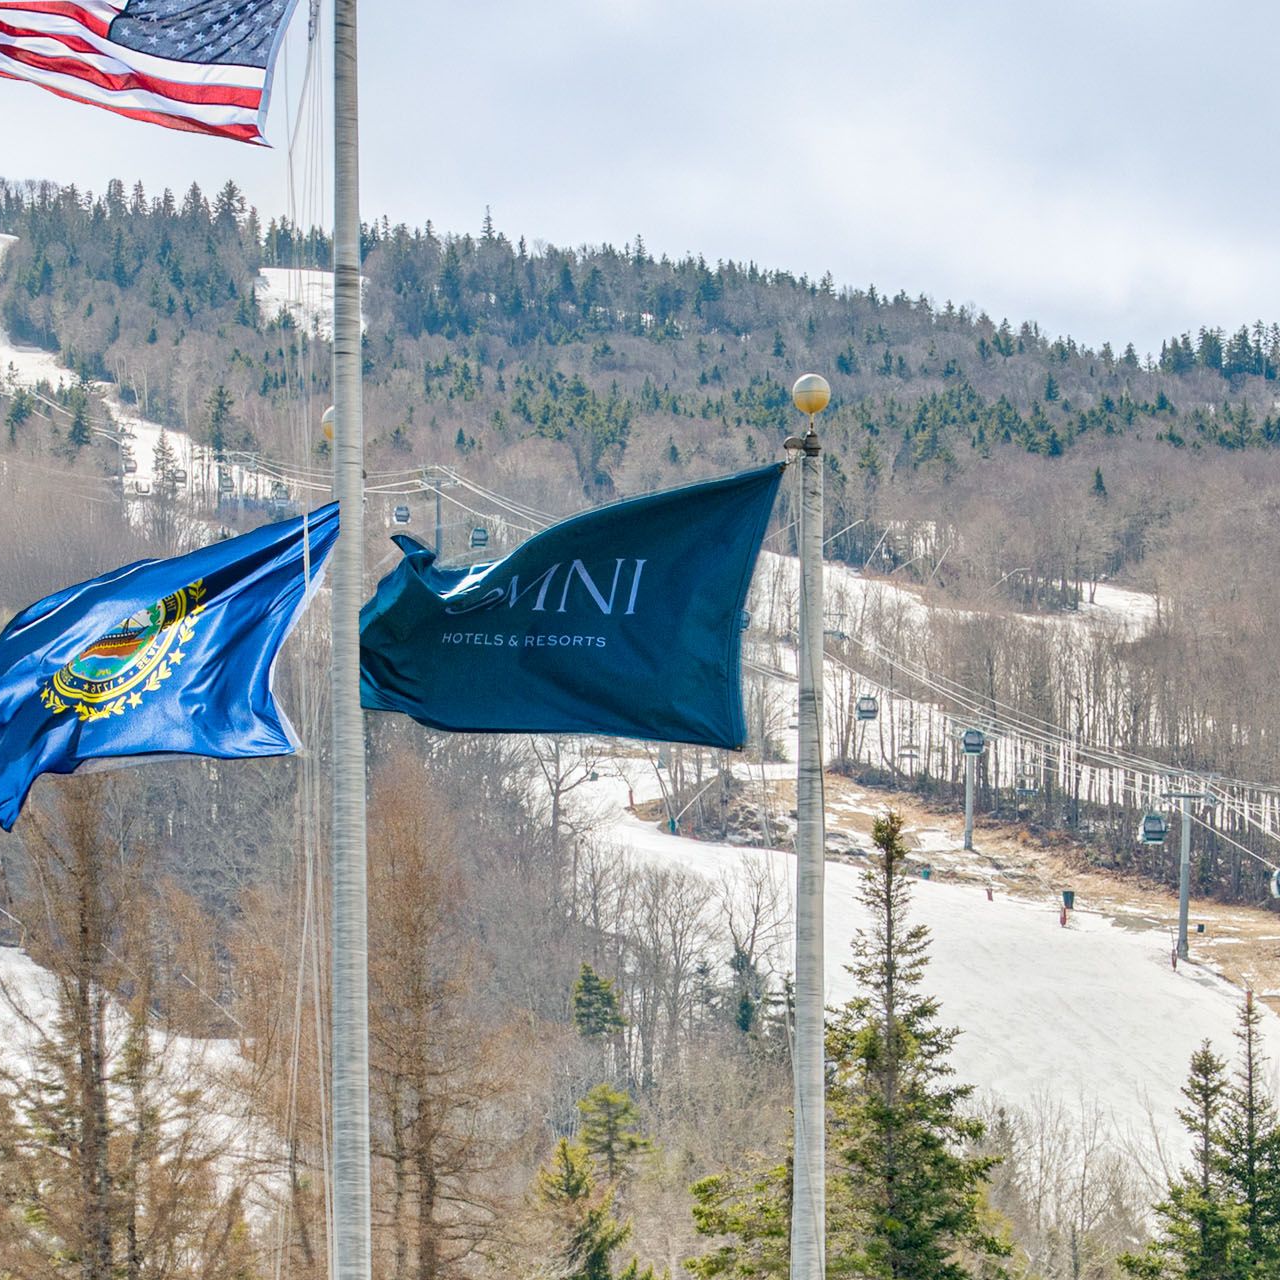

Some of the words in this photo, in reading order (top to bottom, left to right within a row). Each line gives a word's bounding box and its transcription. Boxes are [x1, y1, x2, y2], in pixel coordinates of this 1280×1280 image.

[442, 632, 504, 646] HOTELS
[508, 635, 518, 647] &
[524, 635, 607, 648] RESORTS
